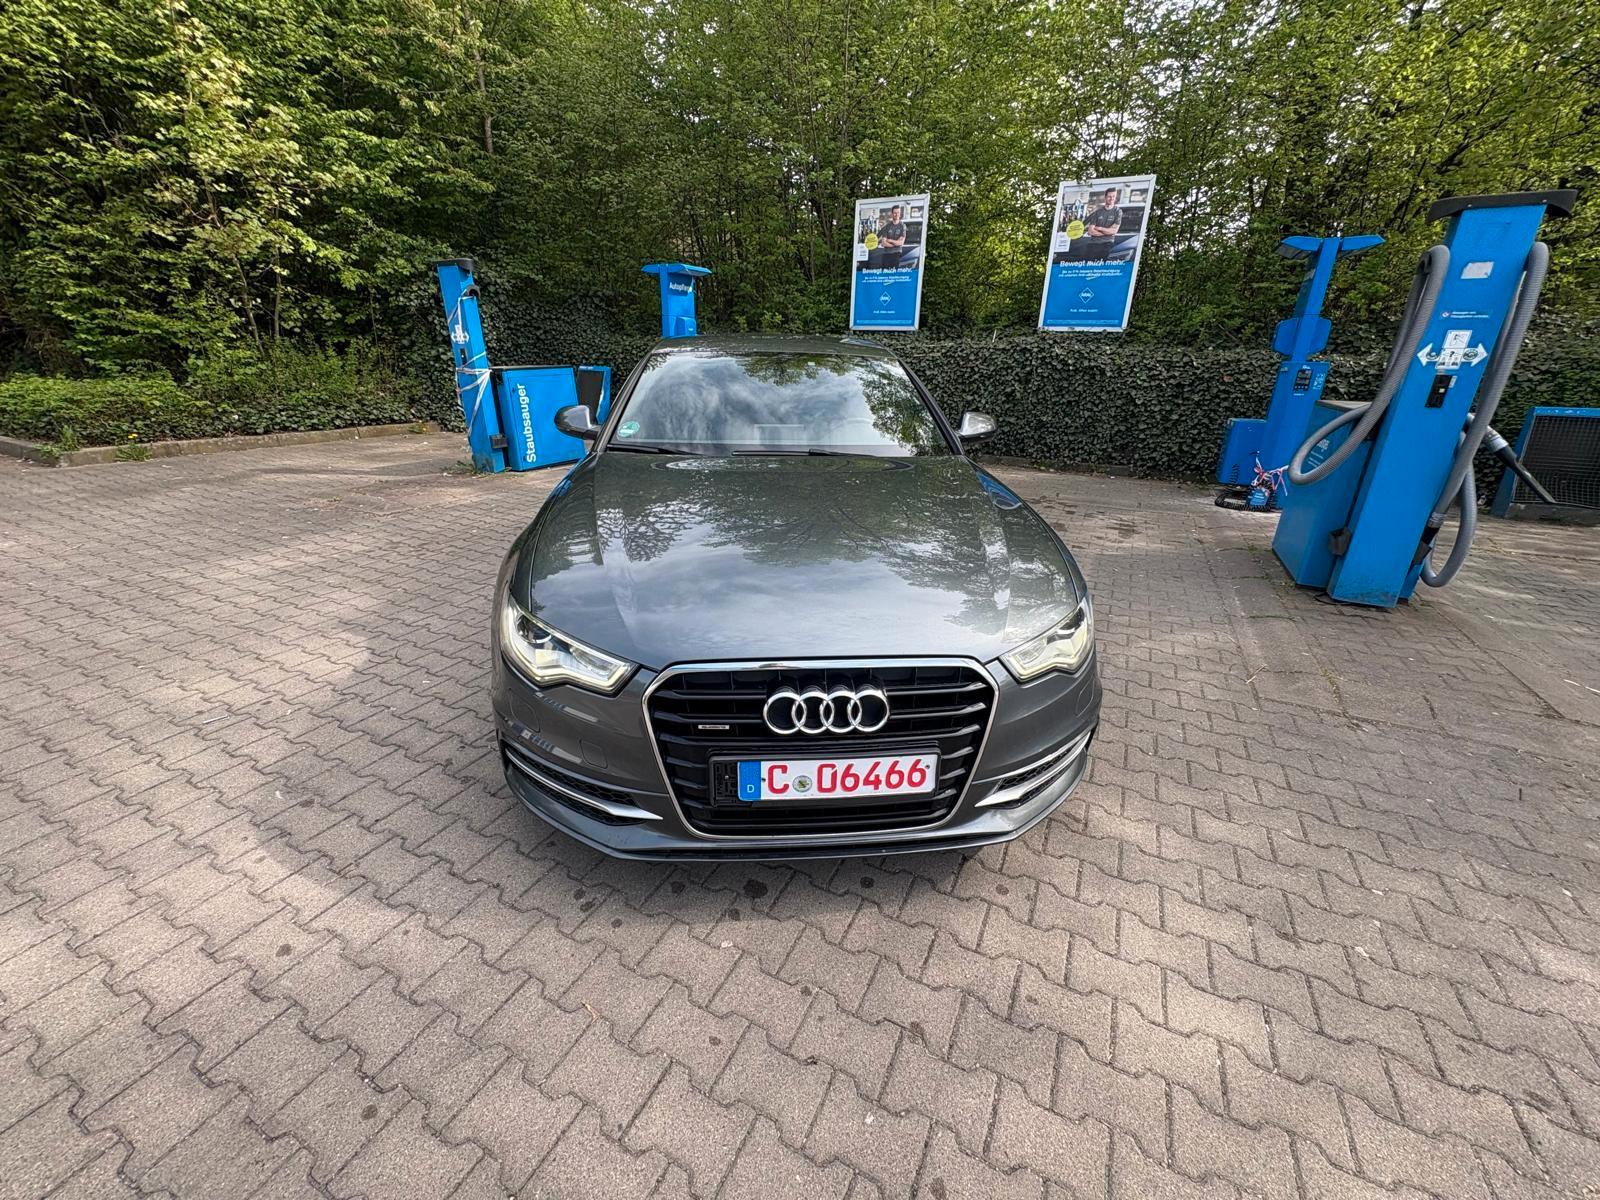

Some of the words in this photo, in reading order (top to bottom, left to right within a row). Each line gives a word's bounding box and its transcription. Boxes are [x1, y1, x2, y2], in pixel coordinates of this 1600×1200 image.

[1086, 258, 1104, 267] mich
[517, 383, 537, 463] Staubsauger
[746, 784, 755, 793] D
[767, 764, 790, 794] C
